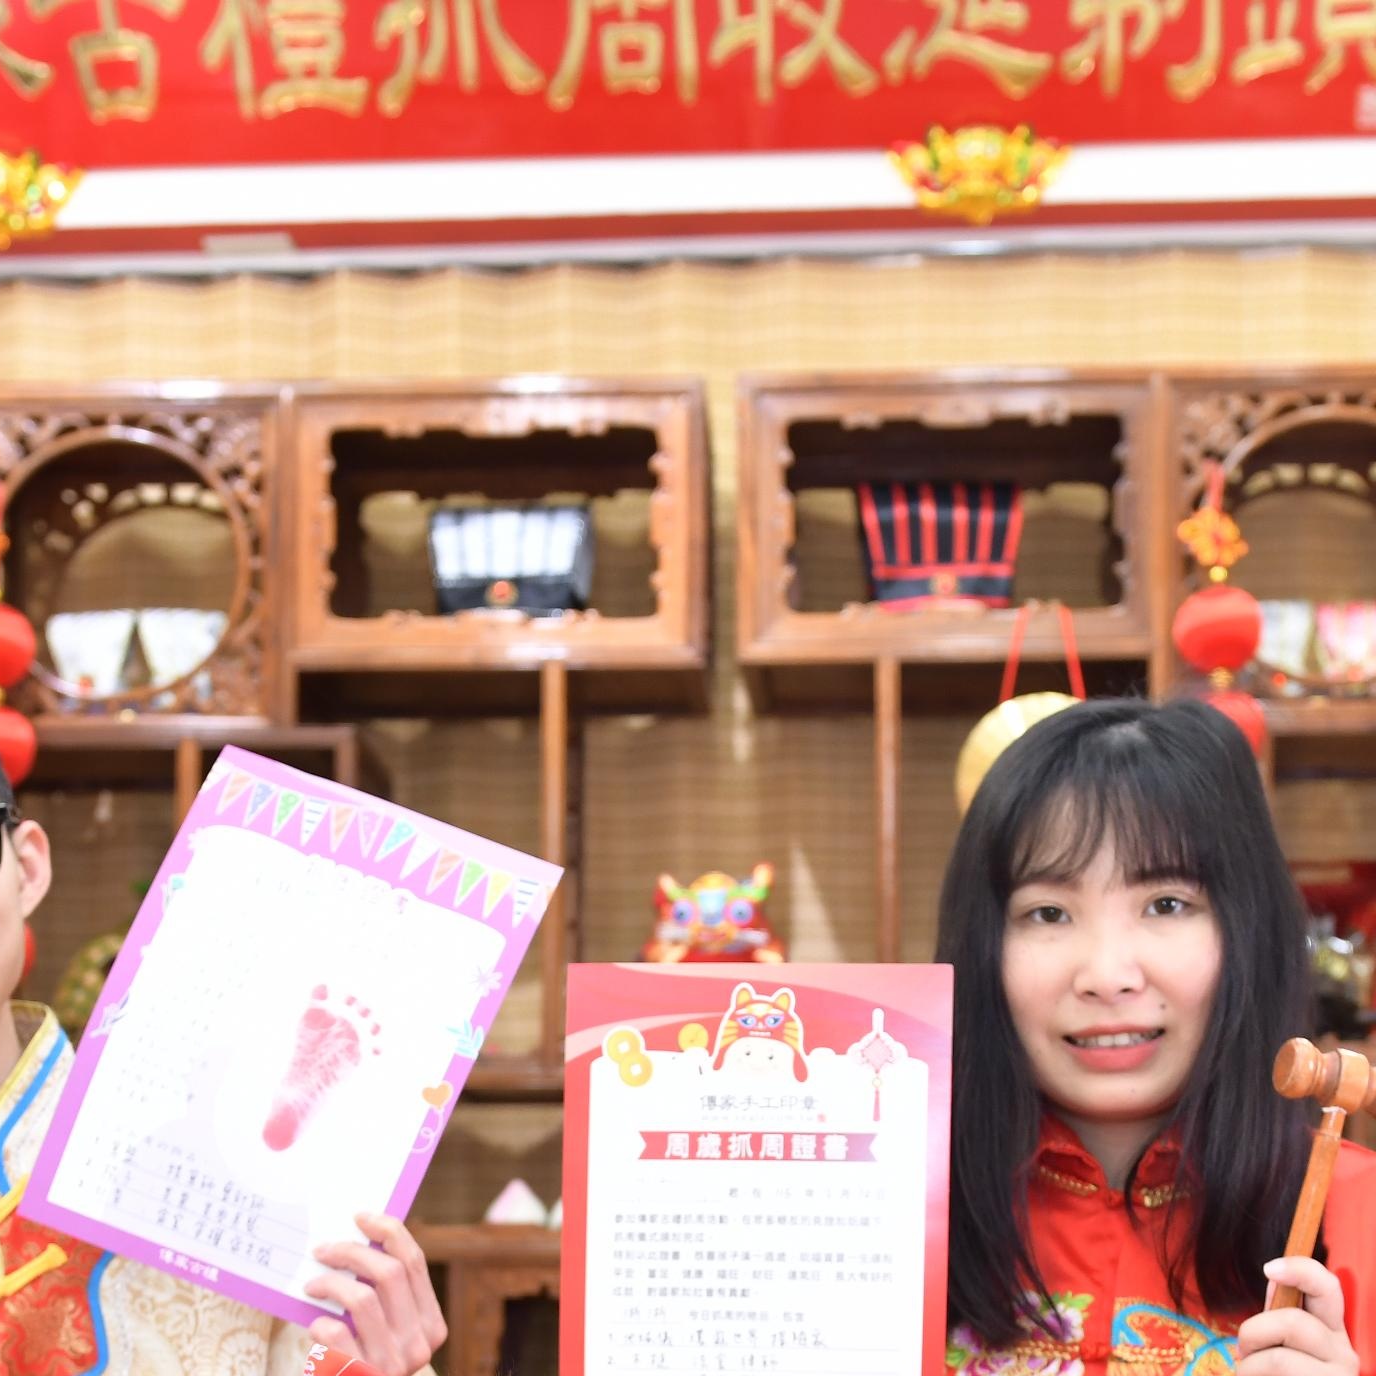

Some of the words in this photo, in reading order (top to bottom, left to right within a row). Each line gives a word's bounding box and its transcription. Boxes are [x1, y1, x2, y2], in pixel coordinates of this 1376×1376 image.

[665, 1132, 849, 1159] 周歲抓周證書
